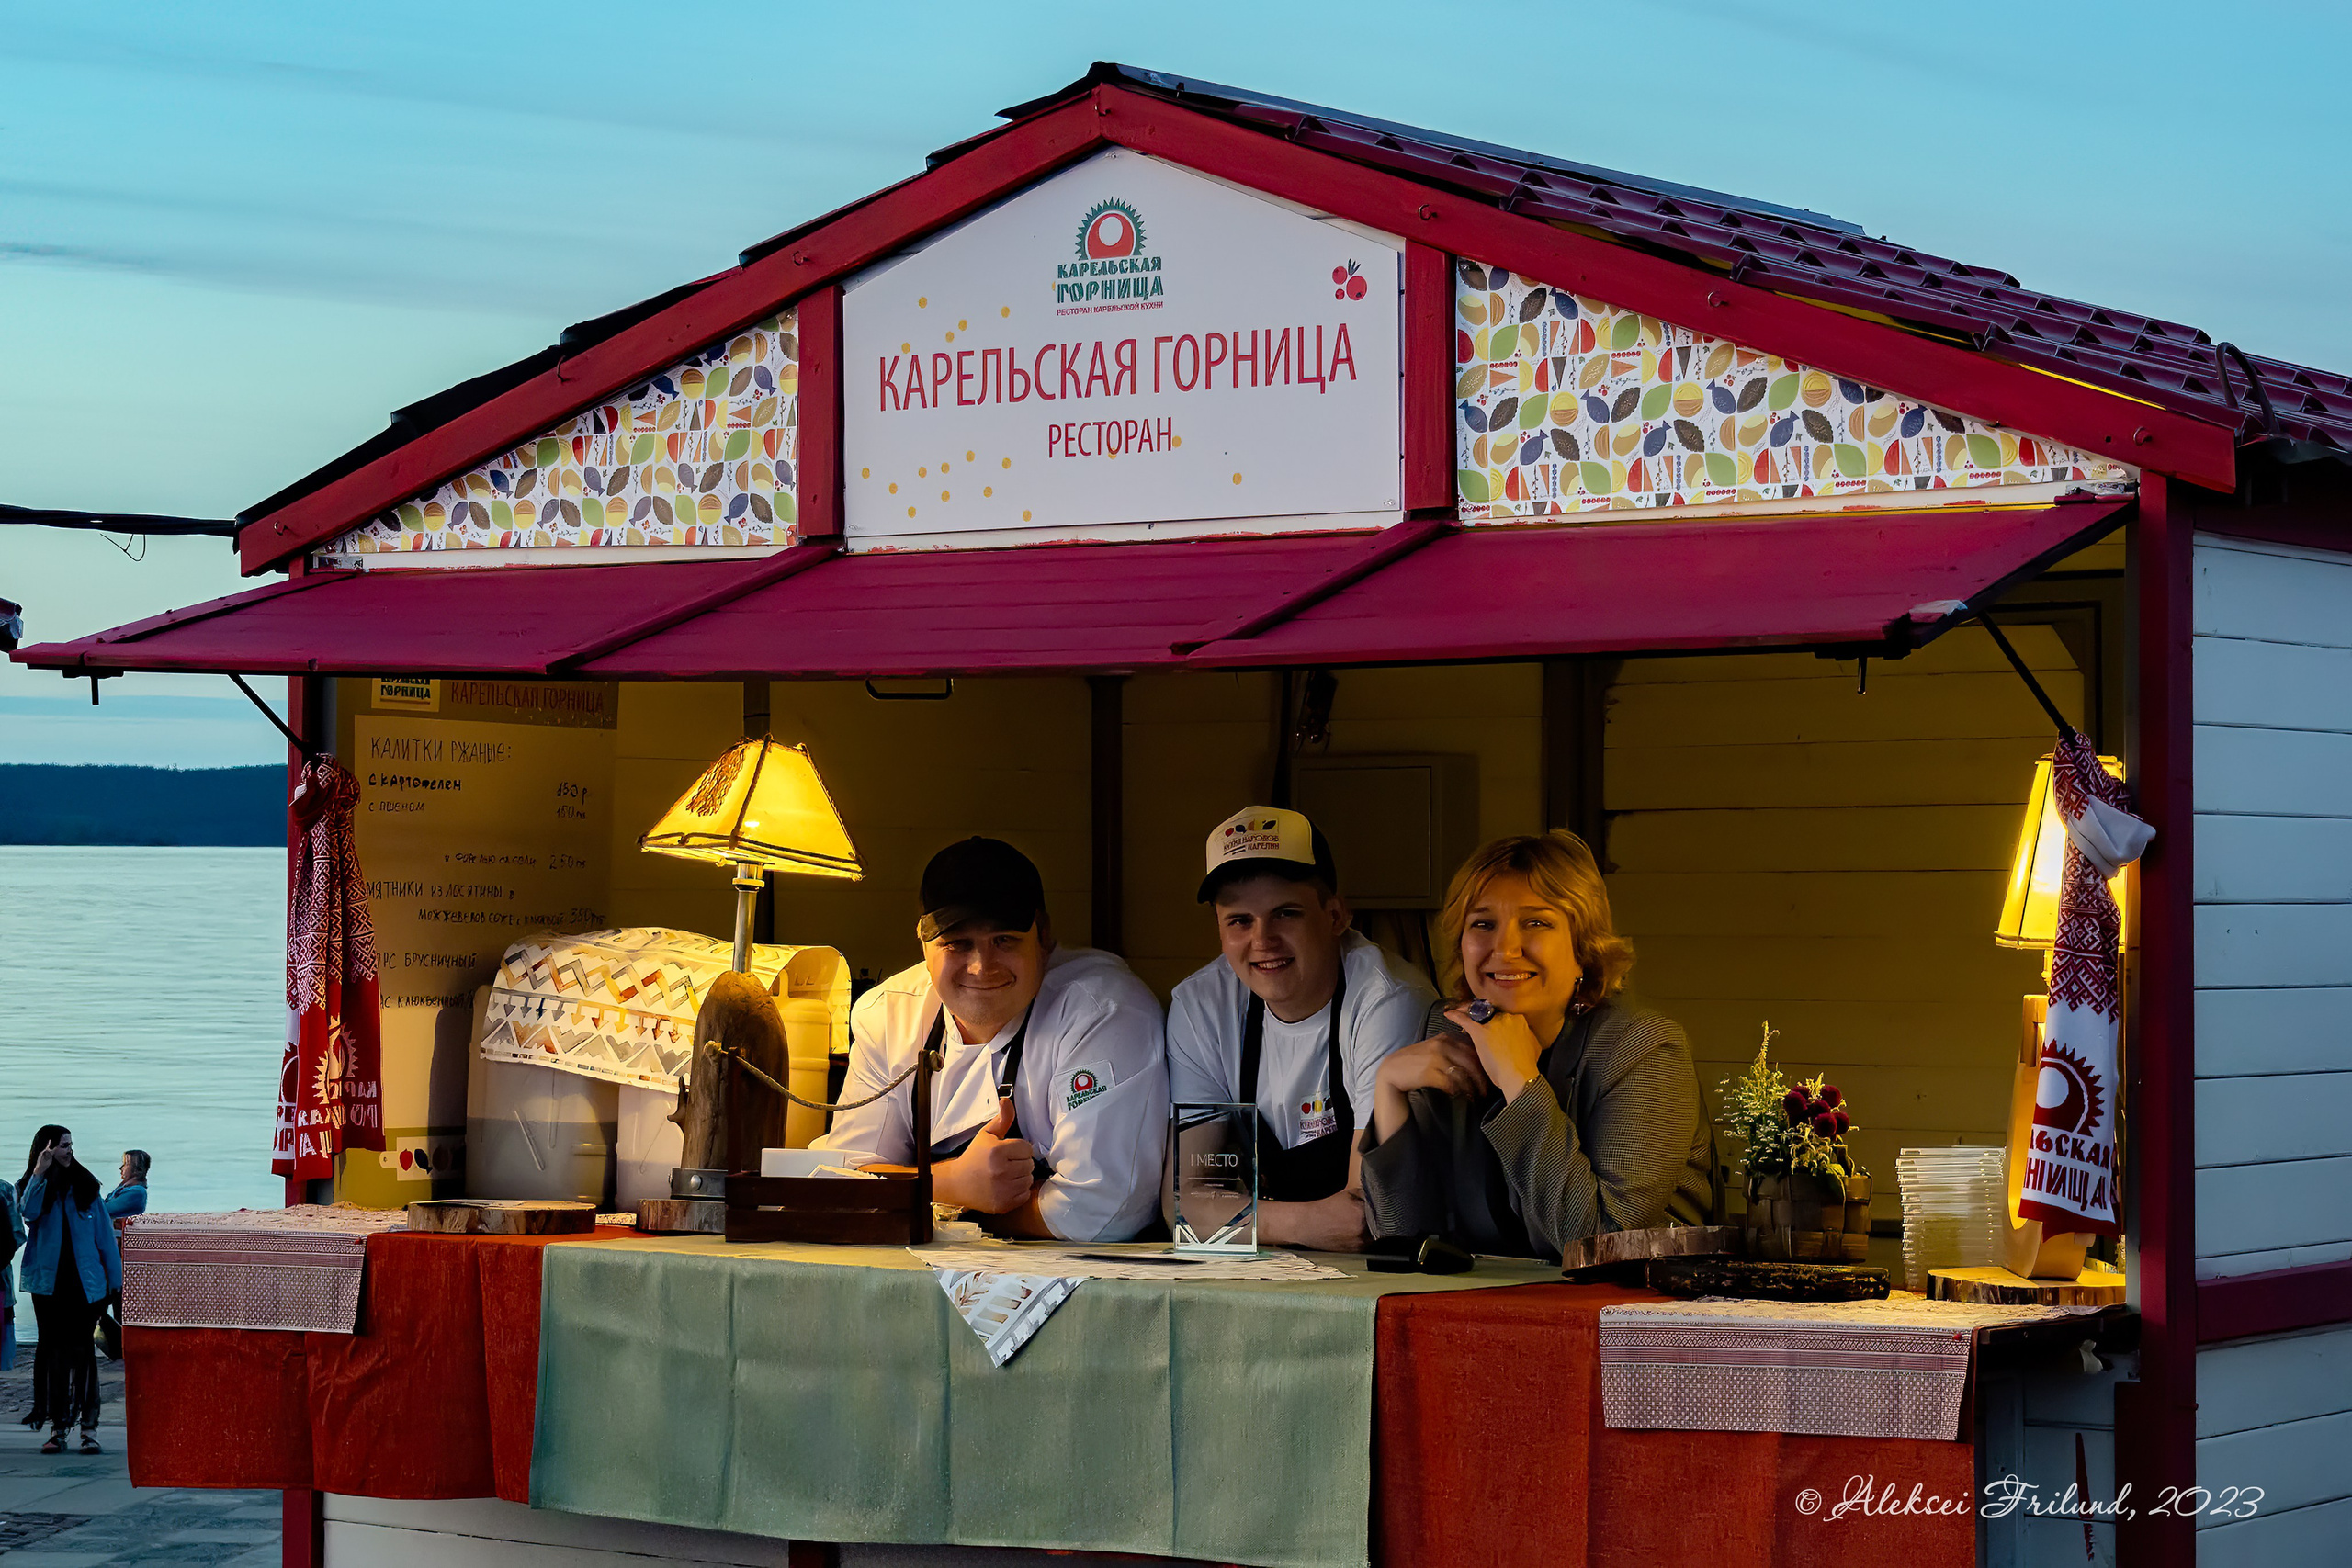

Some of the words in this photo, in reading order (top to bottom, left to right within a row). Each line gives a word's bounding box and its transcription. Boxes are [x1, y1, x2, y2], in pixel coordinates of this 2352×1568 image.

[1057, 257, 1162, 279] КАРЕЛЬСКАЯ
[1057, 276, 1164, 303] ГОРНИЦА
[1057, 306, 1093, 316] РЕСТОРАН
[1093, 302, 1140, 313] КАРЕЛЬСКОЙ
[1140, 301, 1164, 310] КУХНИ
[878, 338, 1137, 412] КАРЕЛЬСКАЯ
[1154, 322, 1357, 395] ГОРНИЦА
[1048, 416, 1173, 458] РЕСТОРАН
[380, 684, 431, 700] ГОРНИЦА
[451, 682, 540, 708] КАРЕЛЬСКАЯ
[542, 687, 604, 716] ГОРНИЦА
[371, 737, 443, 762] КАЛИТКИ
[404, 953, 478, 969] БРУСНИЧНЫЙ
[1196, 1153, 1238, 1168] МЕСТО
